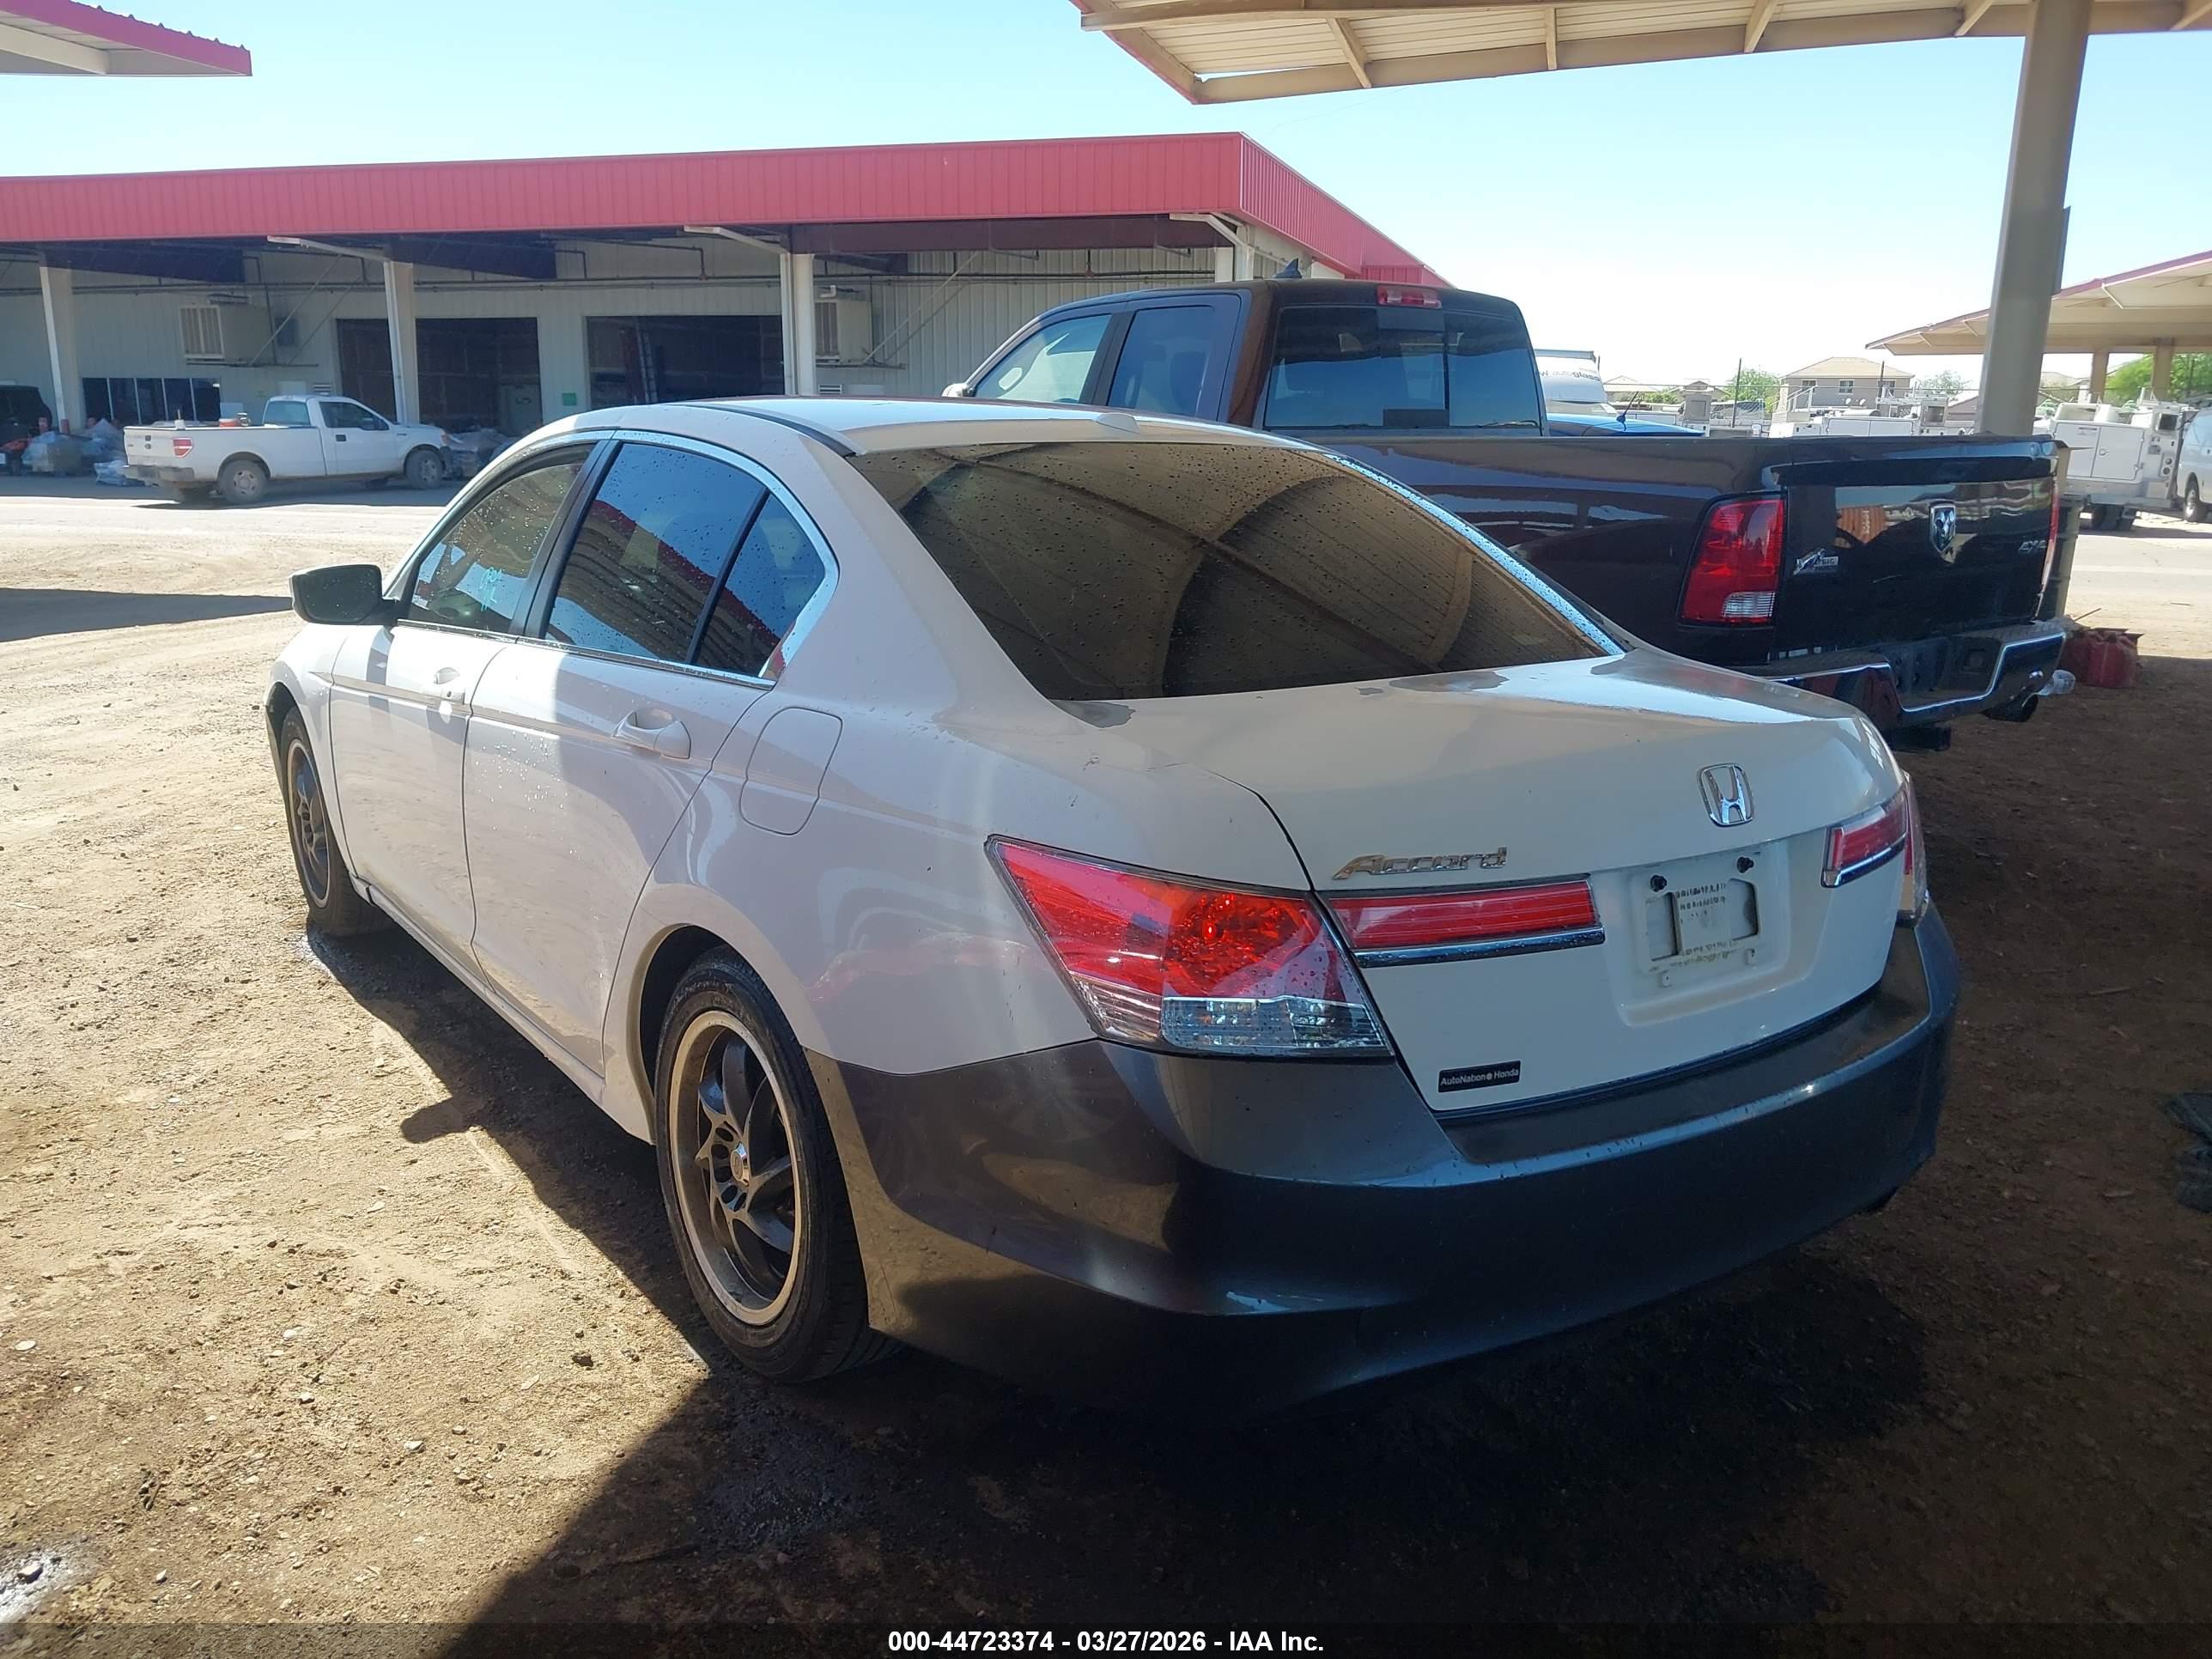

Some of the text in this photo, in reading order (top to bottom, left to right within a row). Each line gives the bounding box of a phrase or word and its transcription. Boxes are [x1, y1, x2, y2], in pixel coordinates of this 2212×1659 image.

[1332, 847, 1508, 880] Accord
[1441, 1067, 1519, 1086] AutoNation Honda
